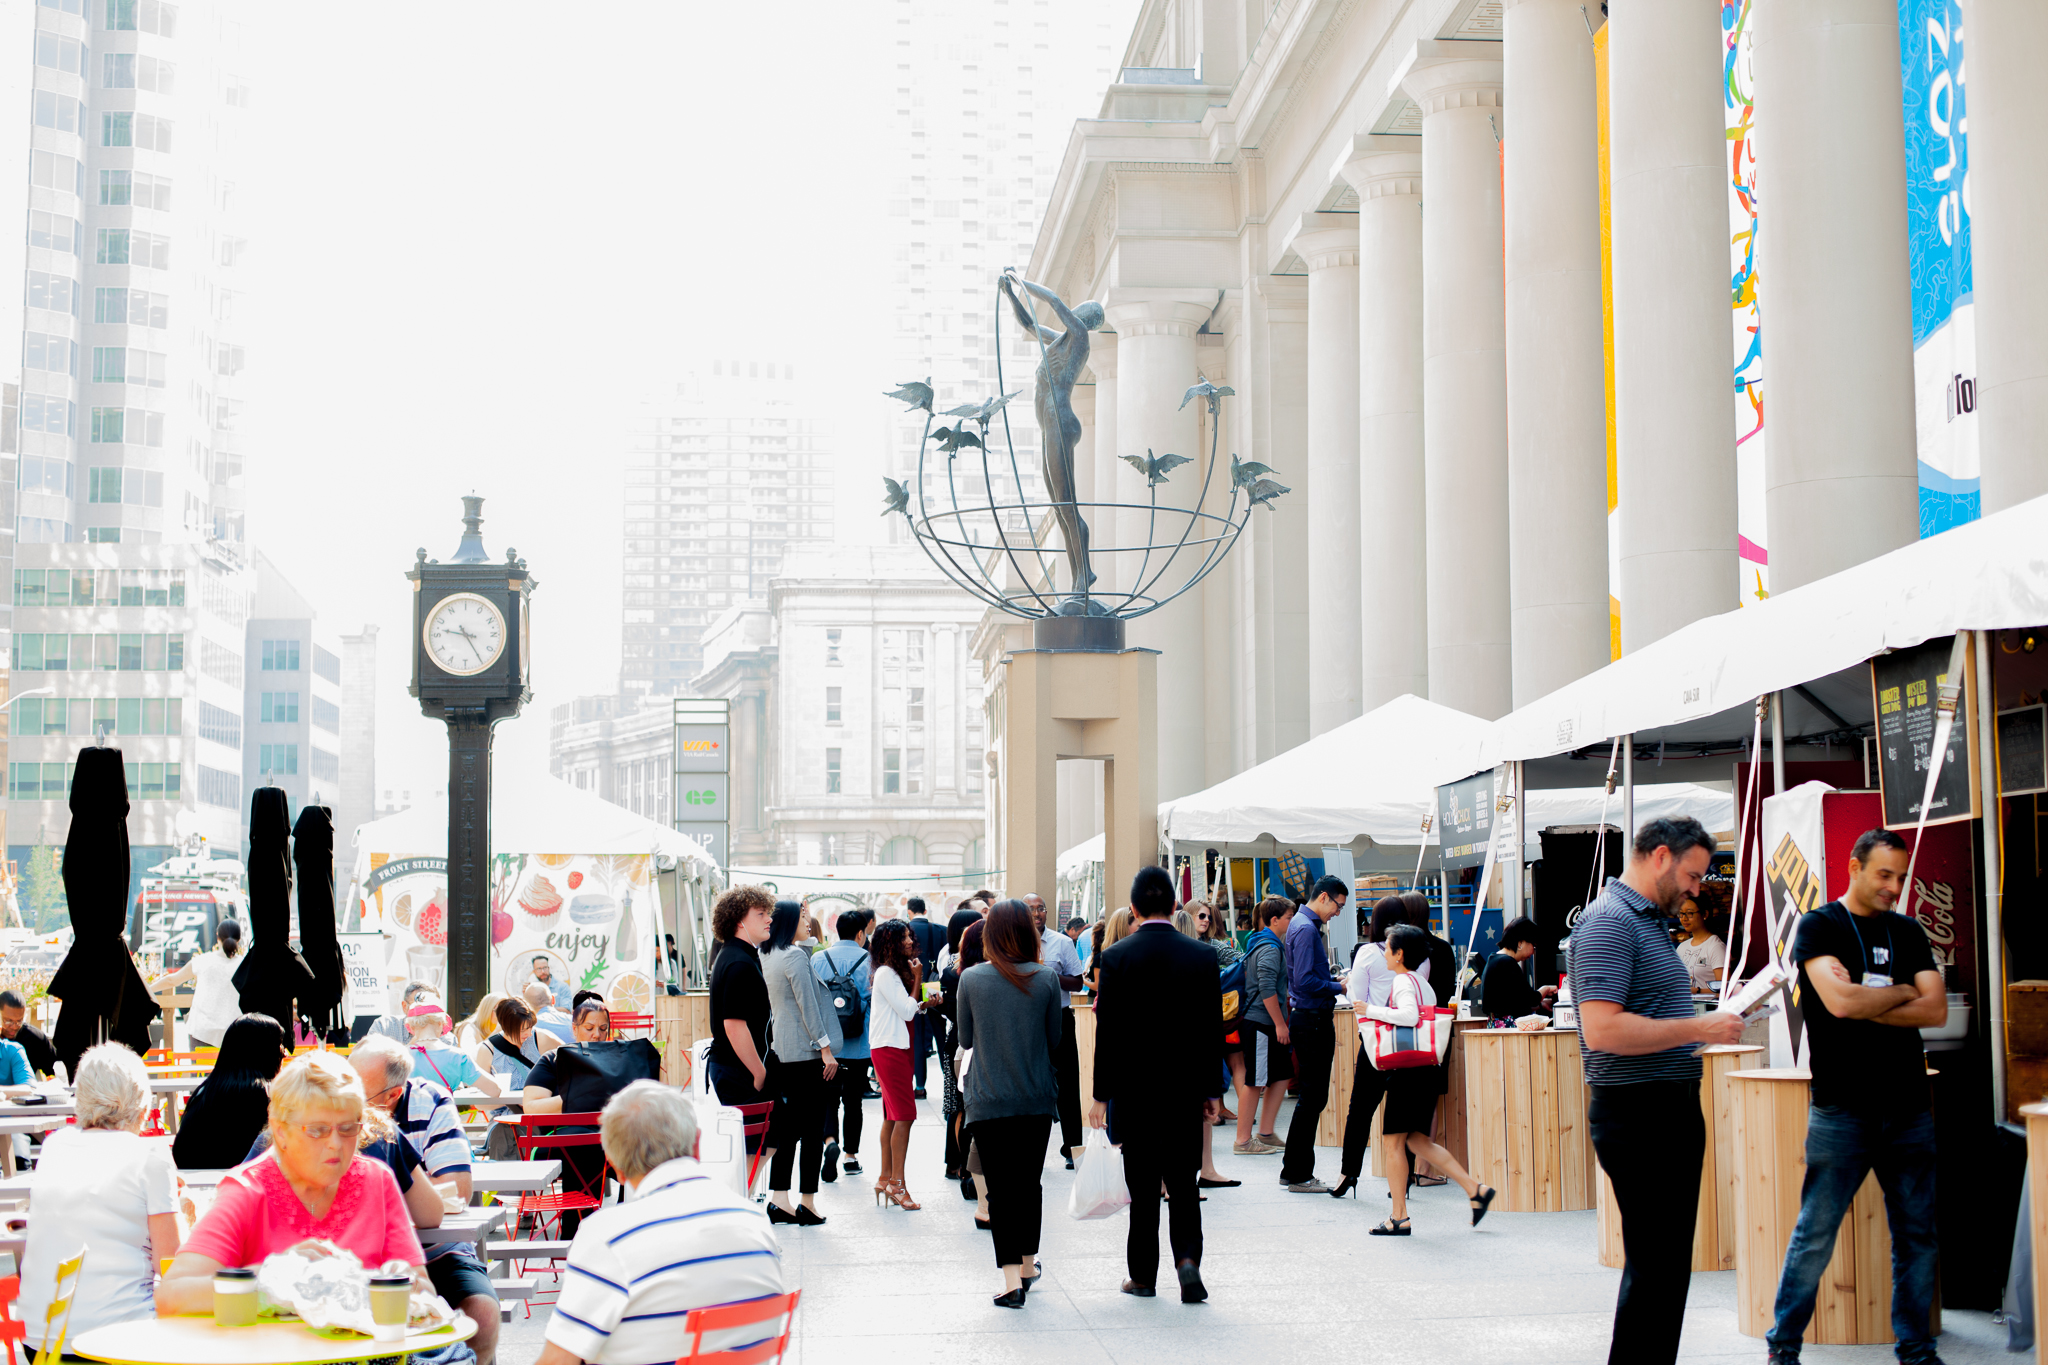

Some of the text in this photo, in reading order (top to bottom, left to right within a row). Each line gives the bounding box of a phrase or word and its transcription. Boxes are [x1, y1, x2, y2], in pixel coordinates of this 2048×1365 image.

[437, 602, 495, 625] UNION
[434, 632, 498, 667] STATON
[1906, 680, 1927, 697] OYSTER
[683, 741, 710, 751] VIA
[1443, 808, 1470, 826] HOLY CHUCK
[378, 860, 448, 880] FRONT STREET
[1766, 832, 1820, 915] YOLO
[147, 911, 208, 931] CP
[138, 930, 200, 954] 24
[545, 927, 610, 962] enjoy
[350, 967, 369, 977] ION
[353, 977, 377, 988] MER
